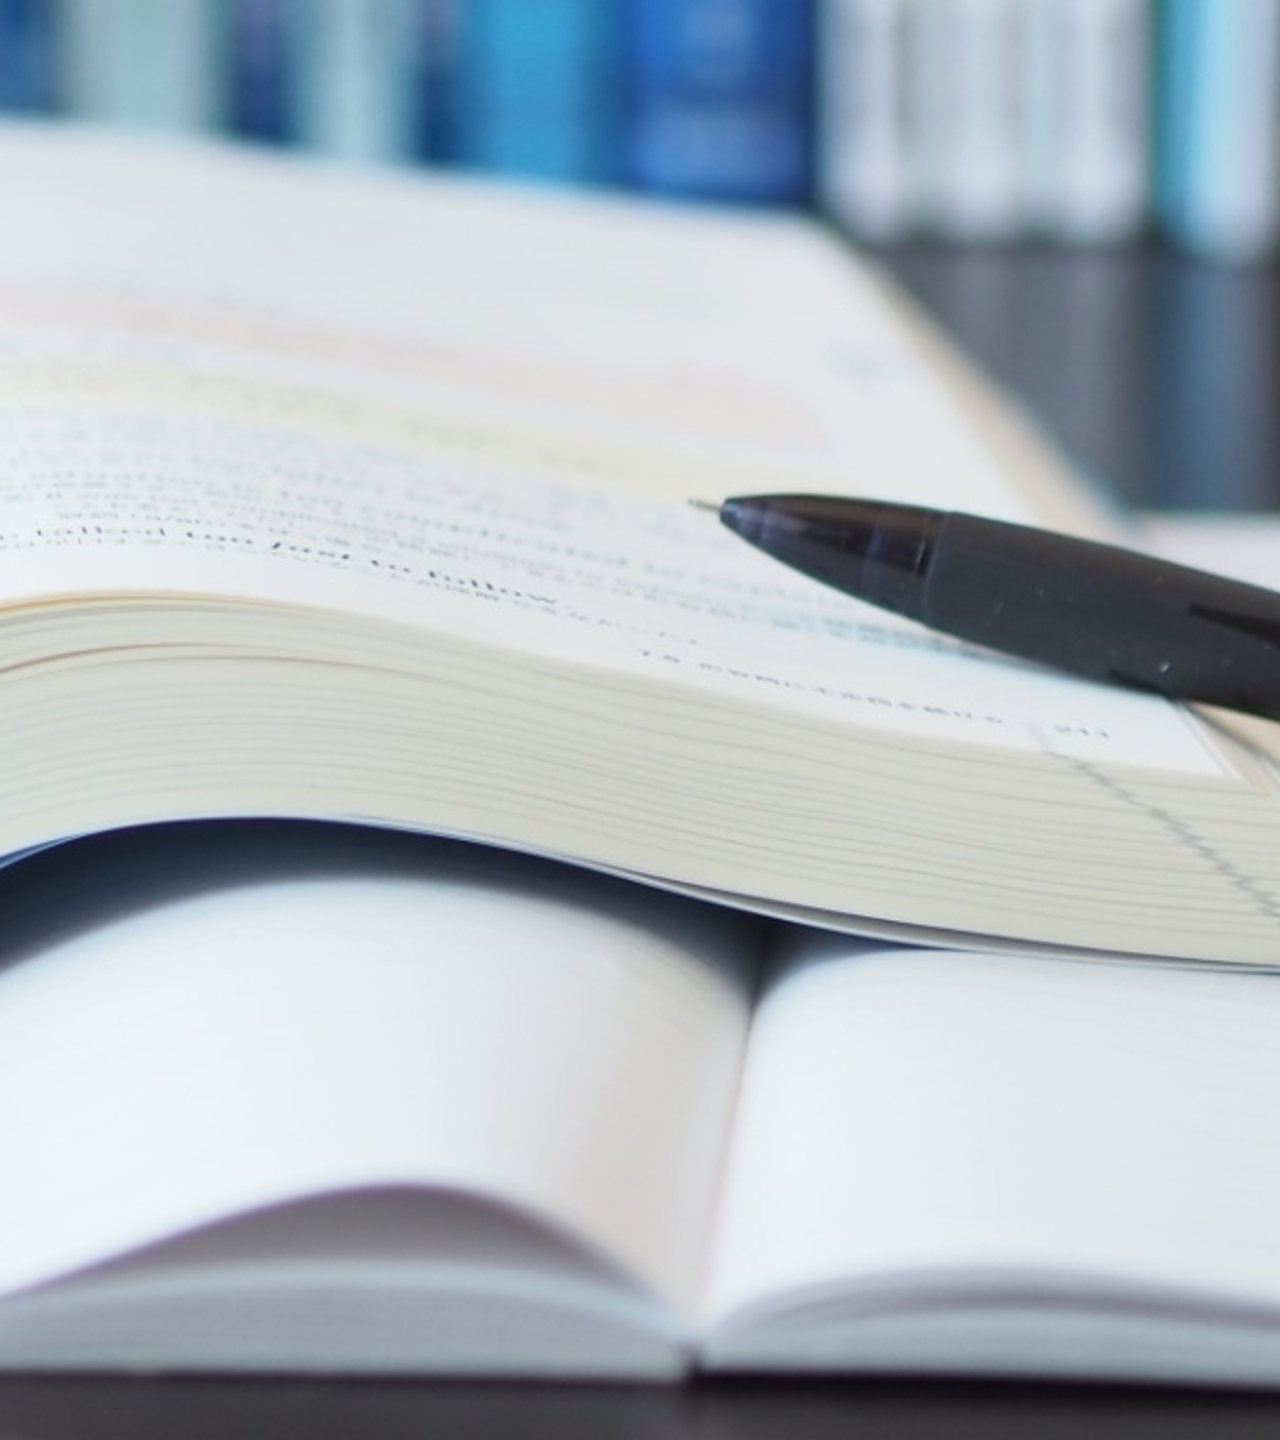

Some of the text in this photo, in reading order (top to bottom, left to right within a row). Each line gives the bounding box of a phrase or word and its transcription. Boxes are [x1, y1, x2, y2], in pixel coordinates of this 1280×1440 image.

[35, 525, 167, 537] talked
[185, 530, 254, 546] too
[270, 541, 351, 562] fast
[370, 558, 412, 574] to
